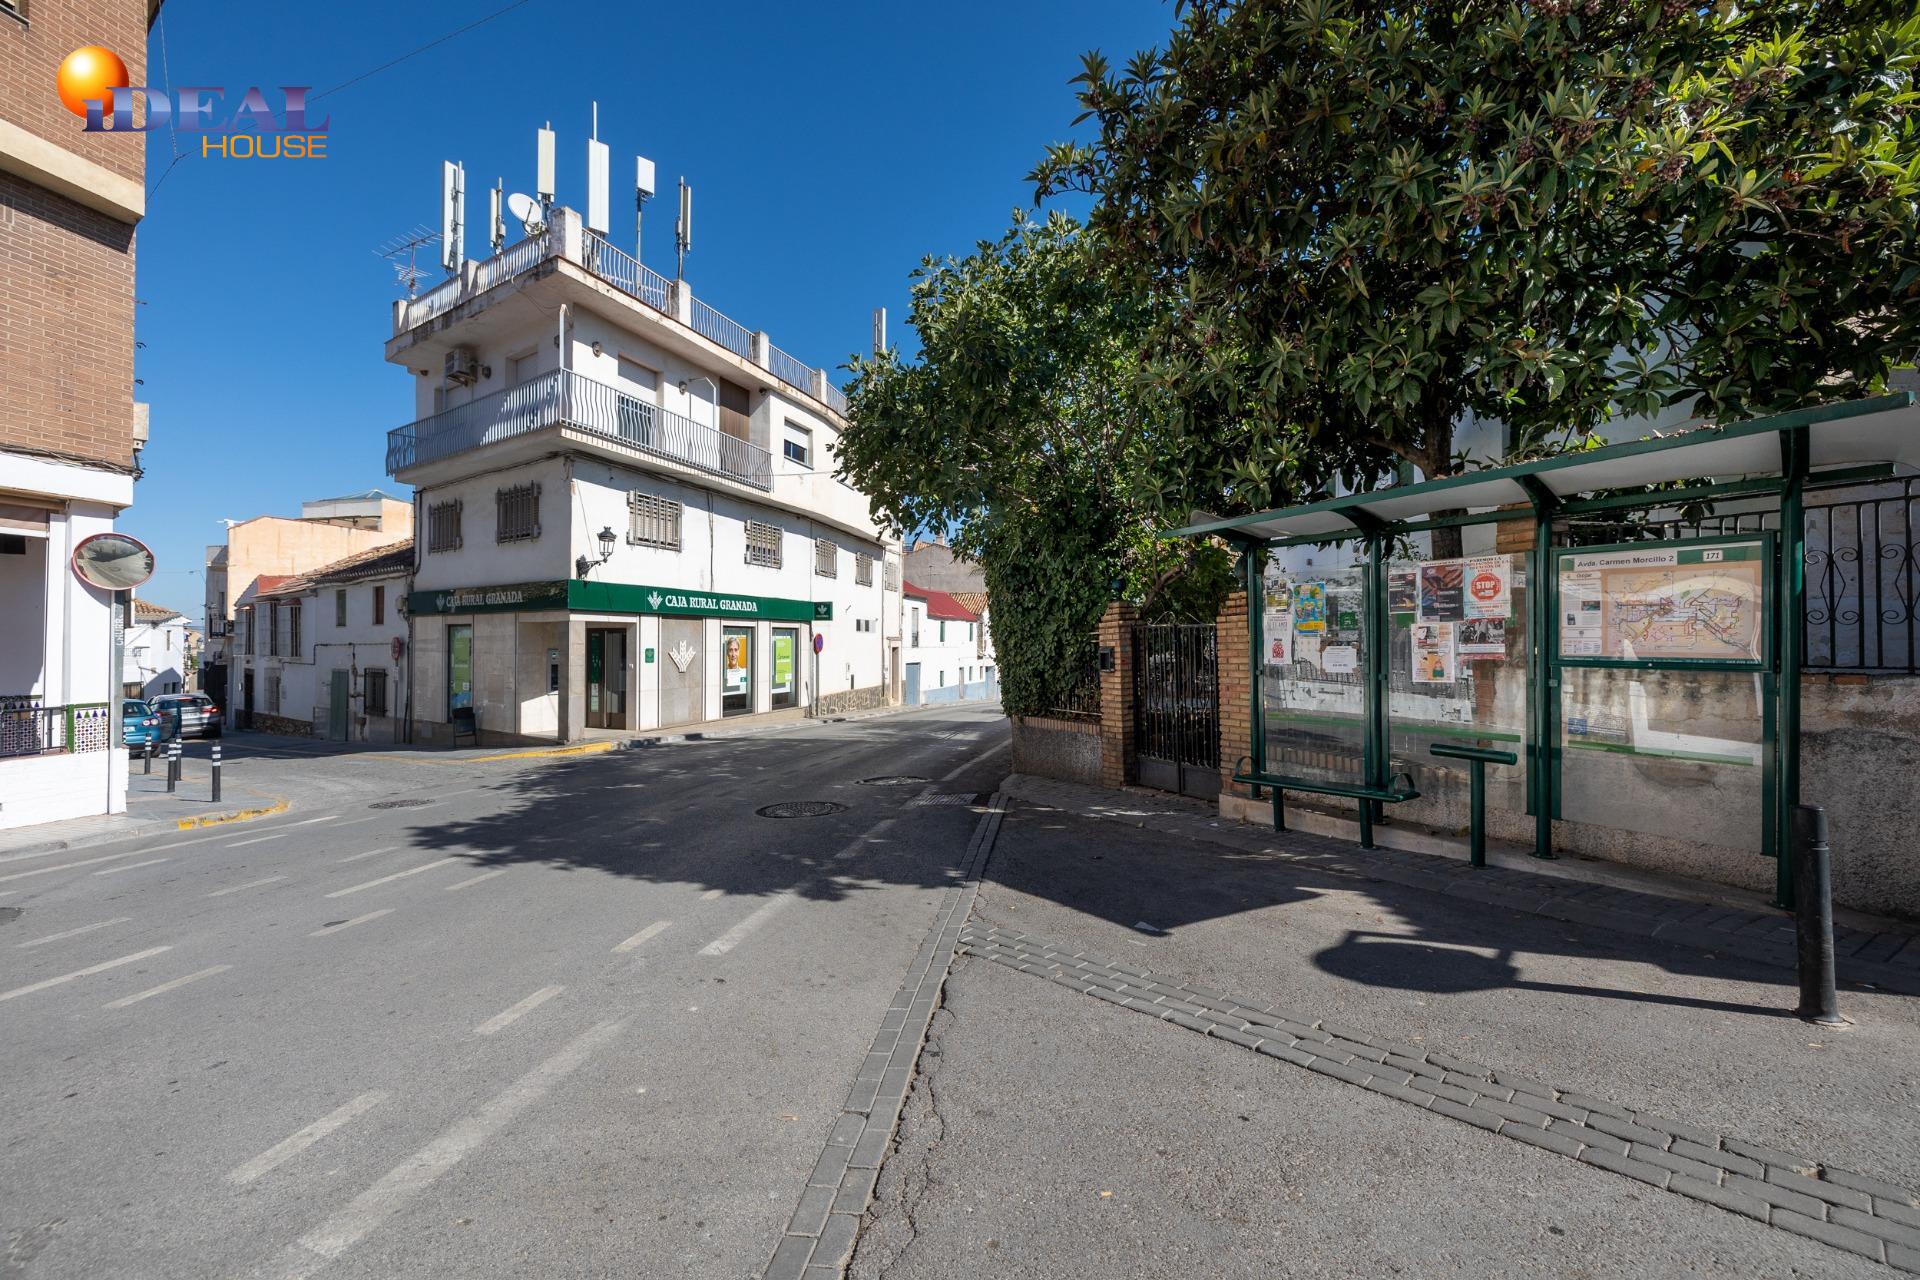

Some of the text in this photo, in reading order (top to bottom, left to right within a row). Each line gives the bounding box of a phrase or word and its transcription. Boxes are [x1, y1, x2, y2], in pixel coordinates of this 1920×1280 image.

[1600, 558, 1631, 566] Carmen
[1633, 555, 1667, 563] Morcillo
[1476, 581, 1495, 589] STOP
[462, 594, 485, 606] RURAL
[486, 591, 523, 604] GRANADA
[665, 595, 758, 612] CAJA RURAL GRANADA
